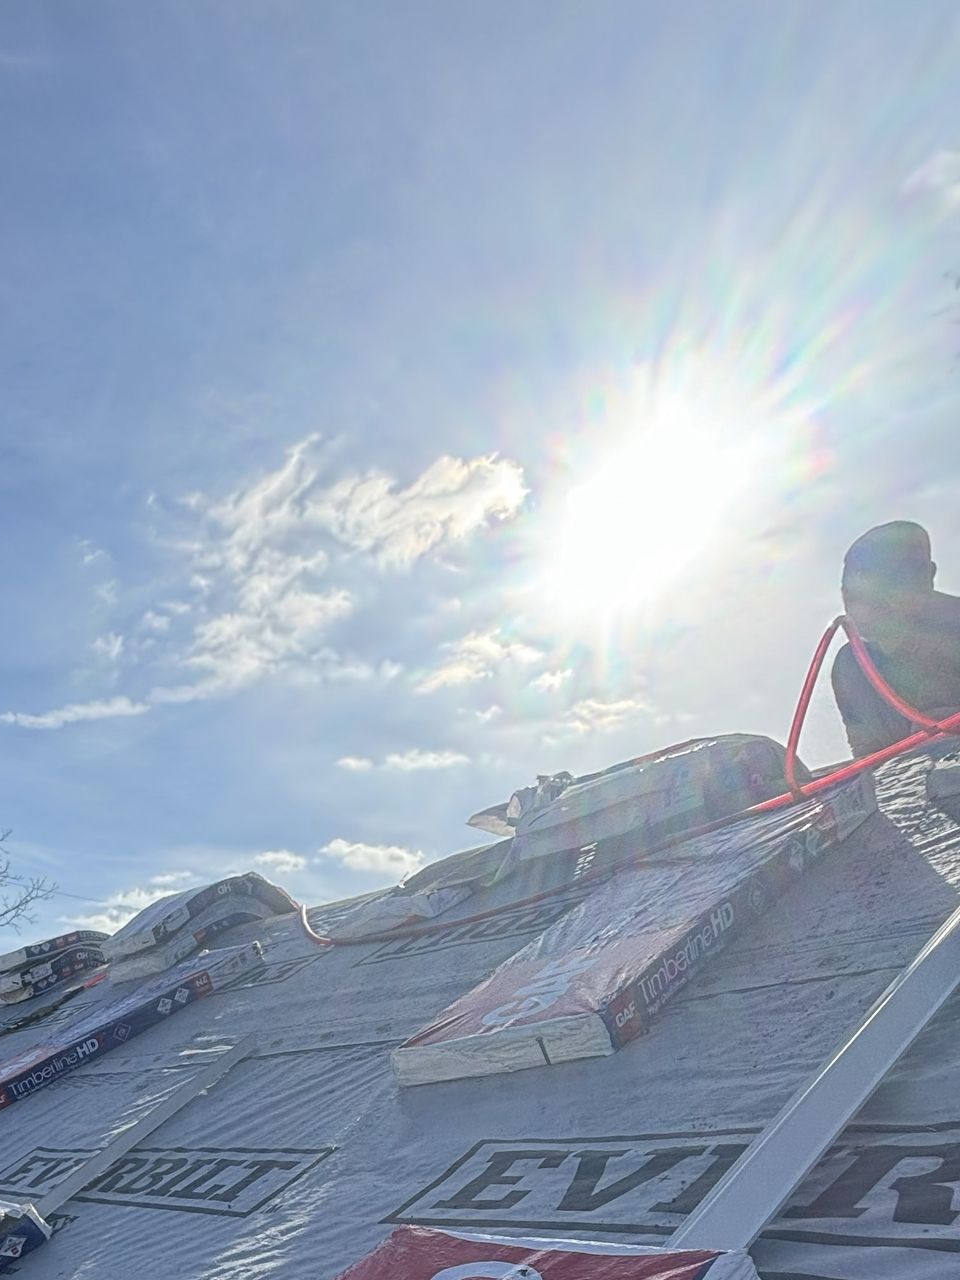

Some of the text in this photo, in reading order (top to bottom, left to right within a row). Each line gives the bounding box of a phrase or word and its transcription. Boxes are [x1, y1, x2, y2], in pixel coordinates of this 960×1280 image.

[638, 924, 713, 1004] Timberline
[615, 1002, 637, 1028] GAF
[8, 1052, 78, 1097] Timberline
